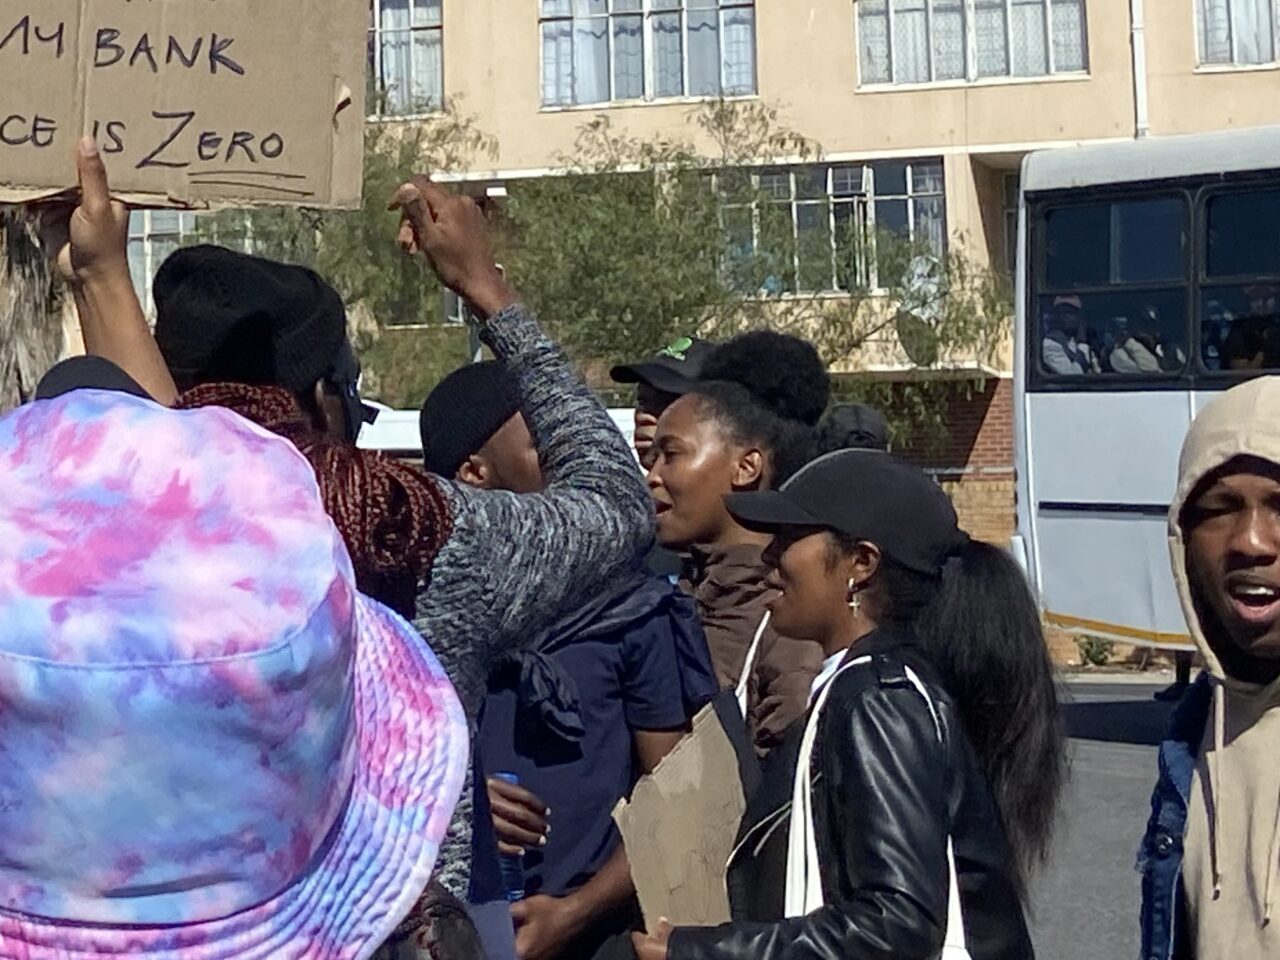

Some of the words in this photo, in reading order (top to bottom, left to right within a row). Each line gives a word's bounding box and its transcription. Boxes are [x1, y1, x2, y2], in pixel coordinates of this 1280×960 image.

[94, 28, 246, 76] BANK
[92, 119, 127, 154] IS
[136, 110, 285, 170] ZERO
